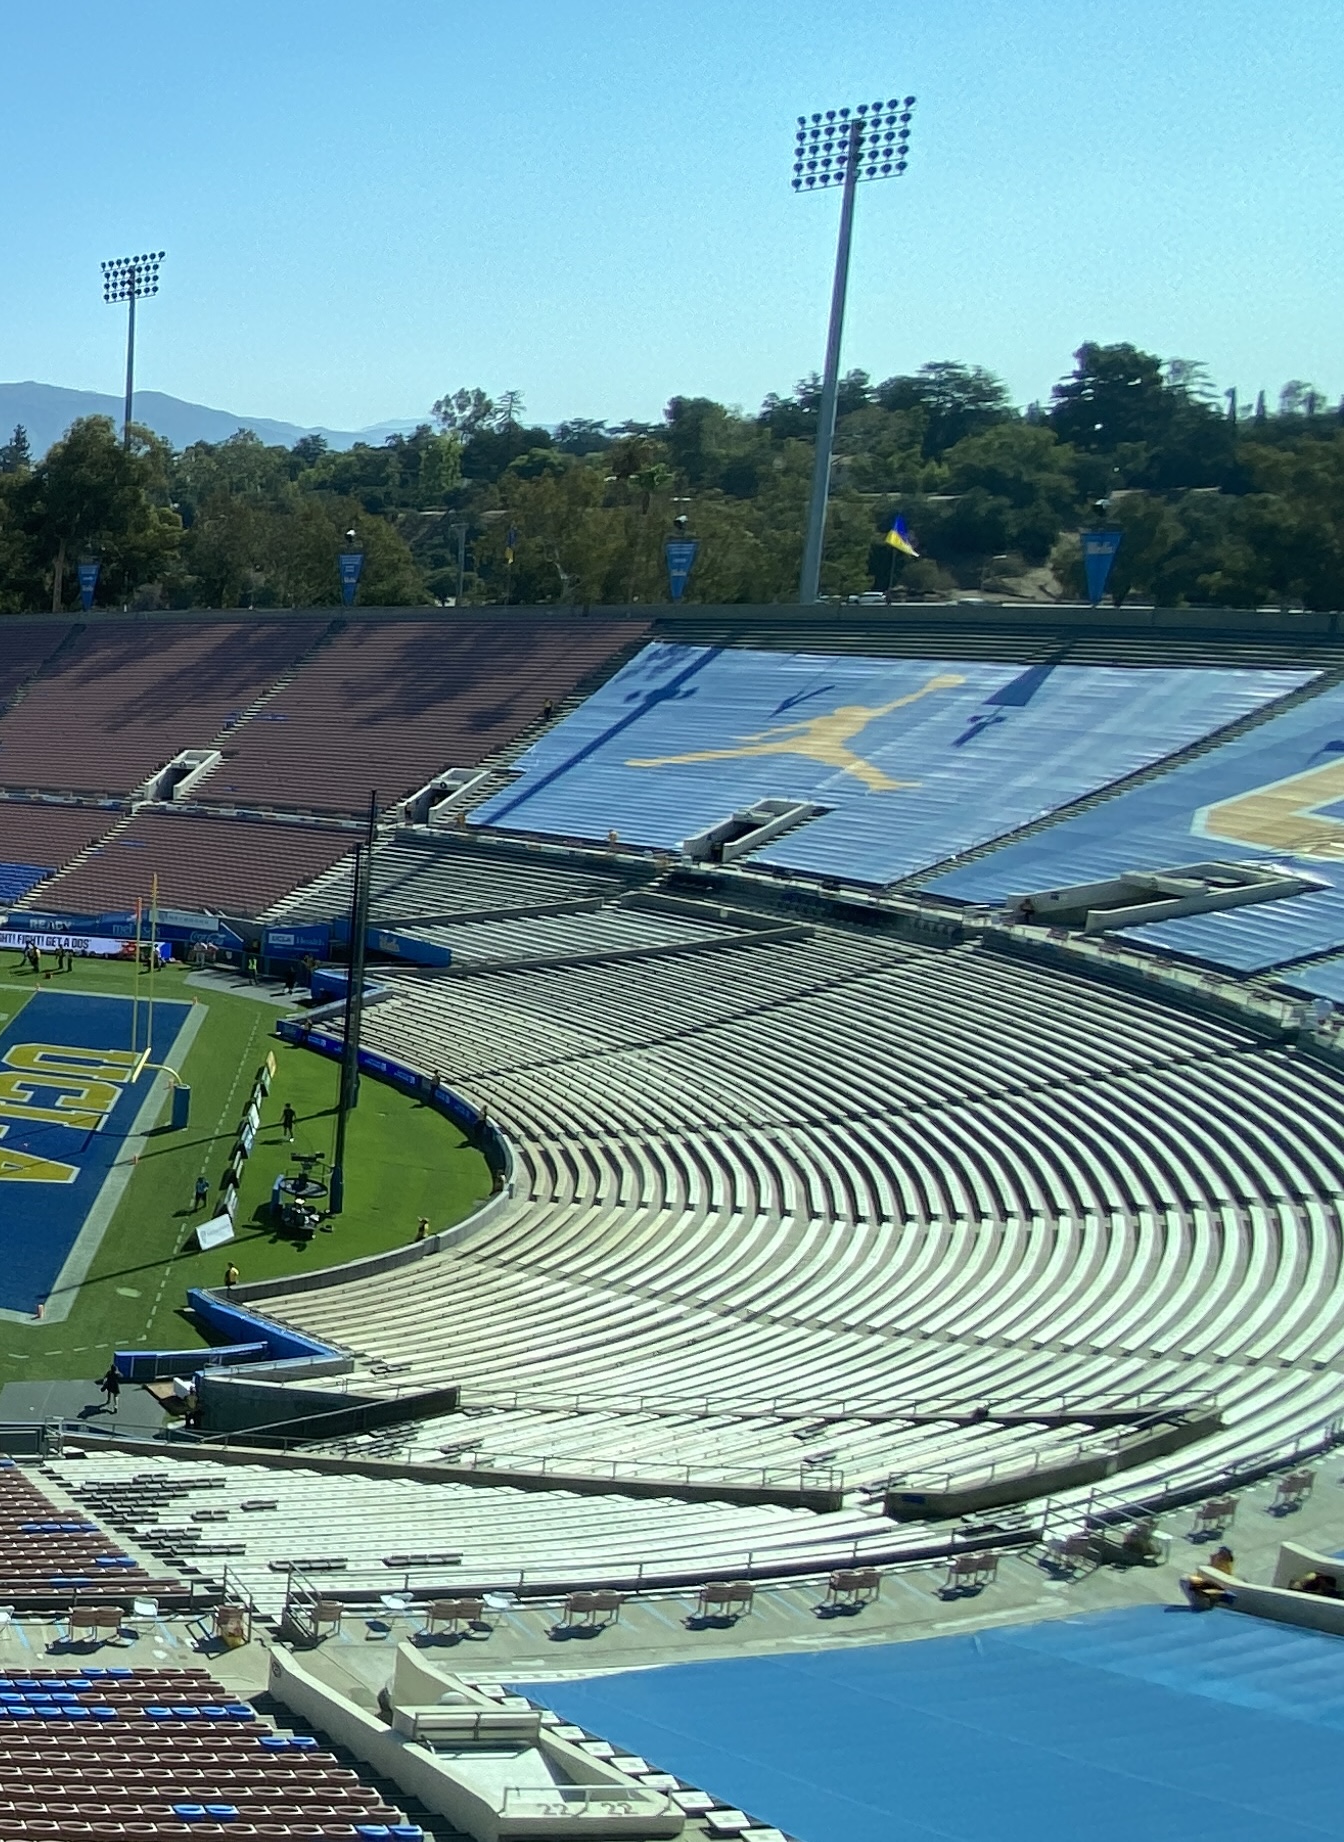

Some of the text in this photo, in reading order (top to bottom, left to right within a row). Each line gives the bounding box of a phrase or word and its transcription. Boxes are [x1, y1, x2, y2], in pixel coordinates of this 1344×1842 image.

[30, 918, 72, 931] READY
[46, 936, 62, 948] GET
[537, 1803, 570, 1816] 22
[601, 1801, 633, 1815] 22
